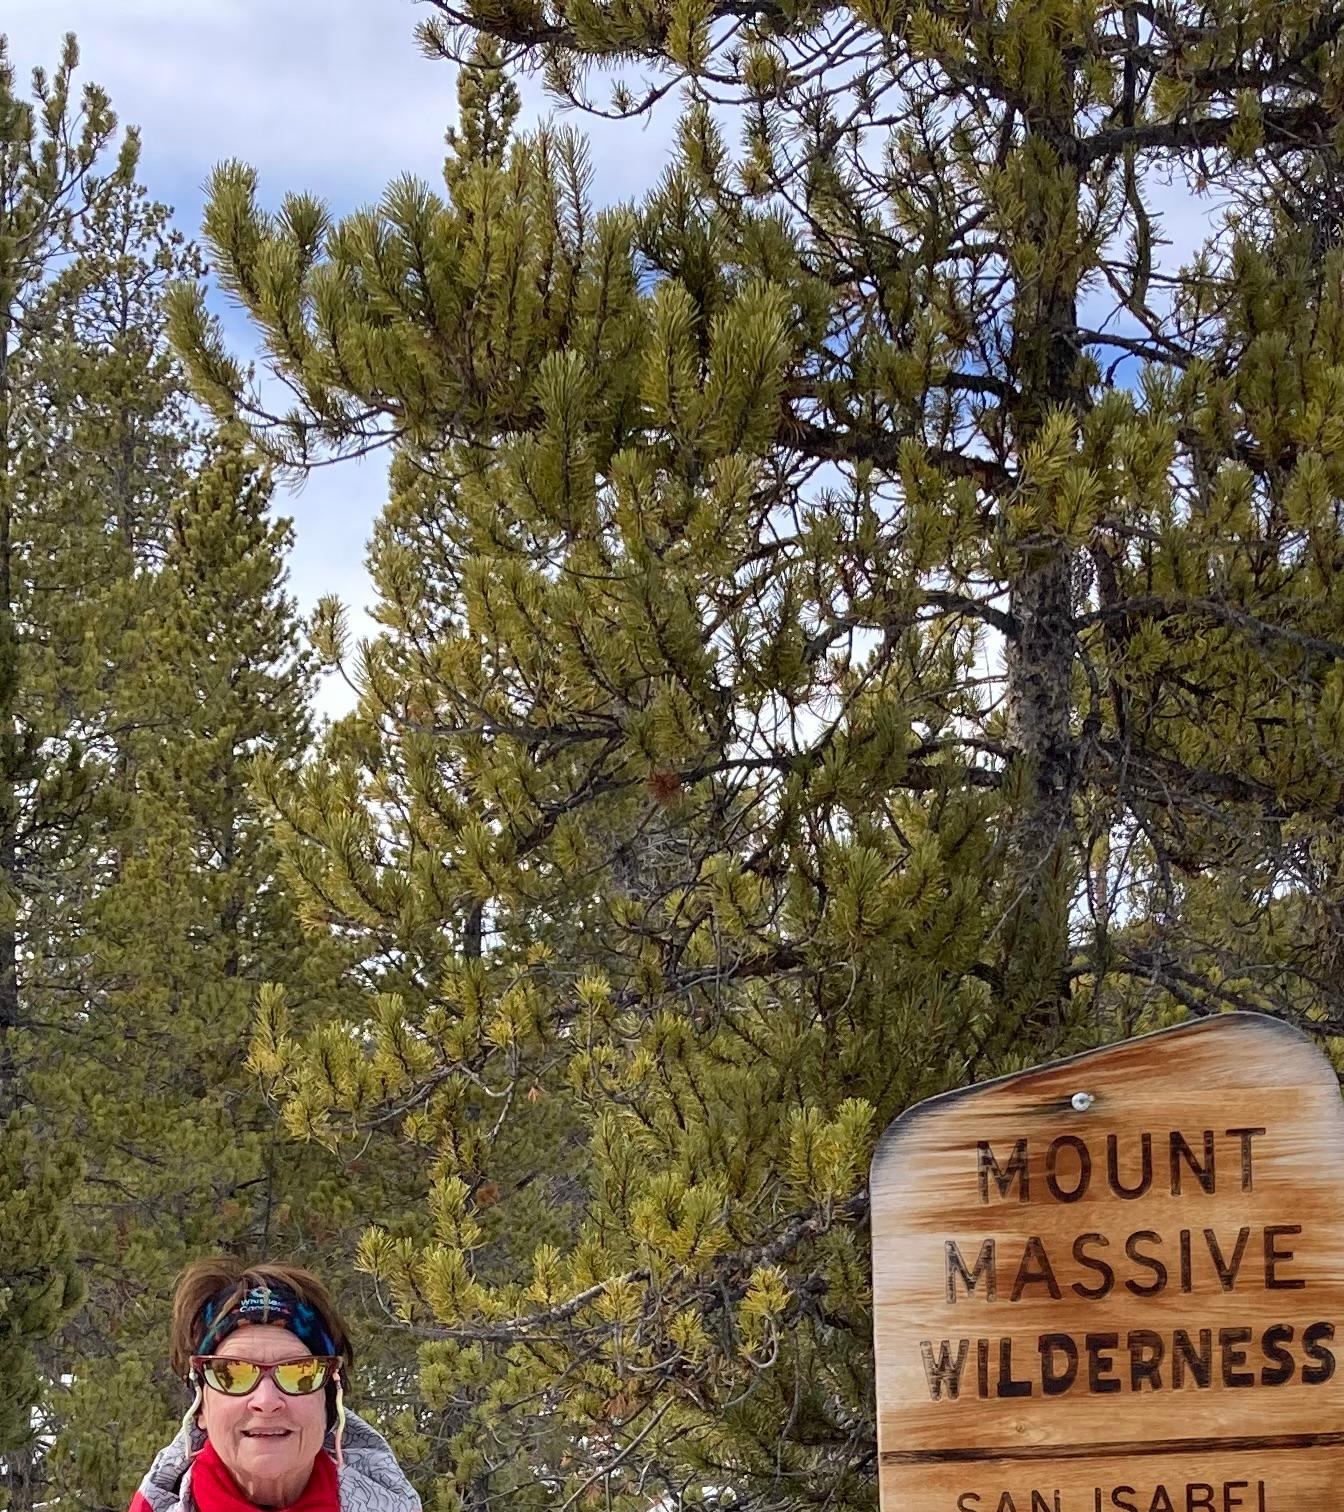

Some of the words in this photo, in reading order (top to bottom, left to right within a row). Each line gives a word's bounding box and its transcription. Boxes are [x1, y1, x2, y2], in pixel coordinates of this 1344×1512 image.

[976, 1127, 1267, 1205] MOUNT
[944, 1224, 1307, 1304] MASSIVE
[919, 1321, 1337, 1402] WILDERNESS
